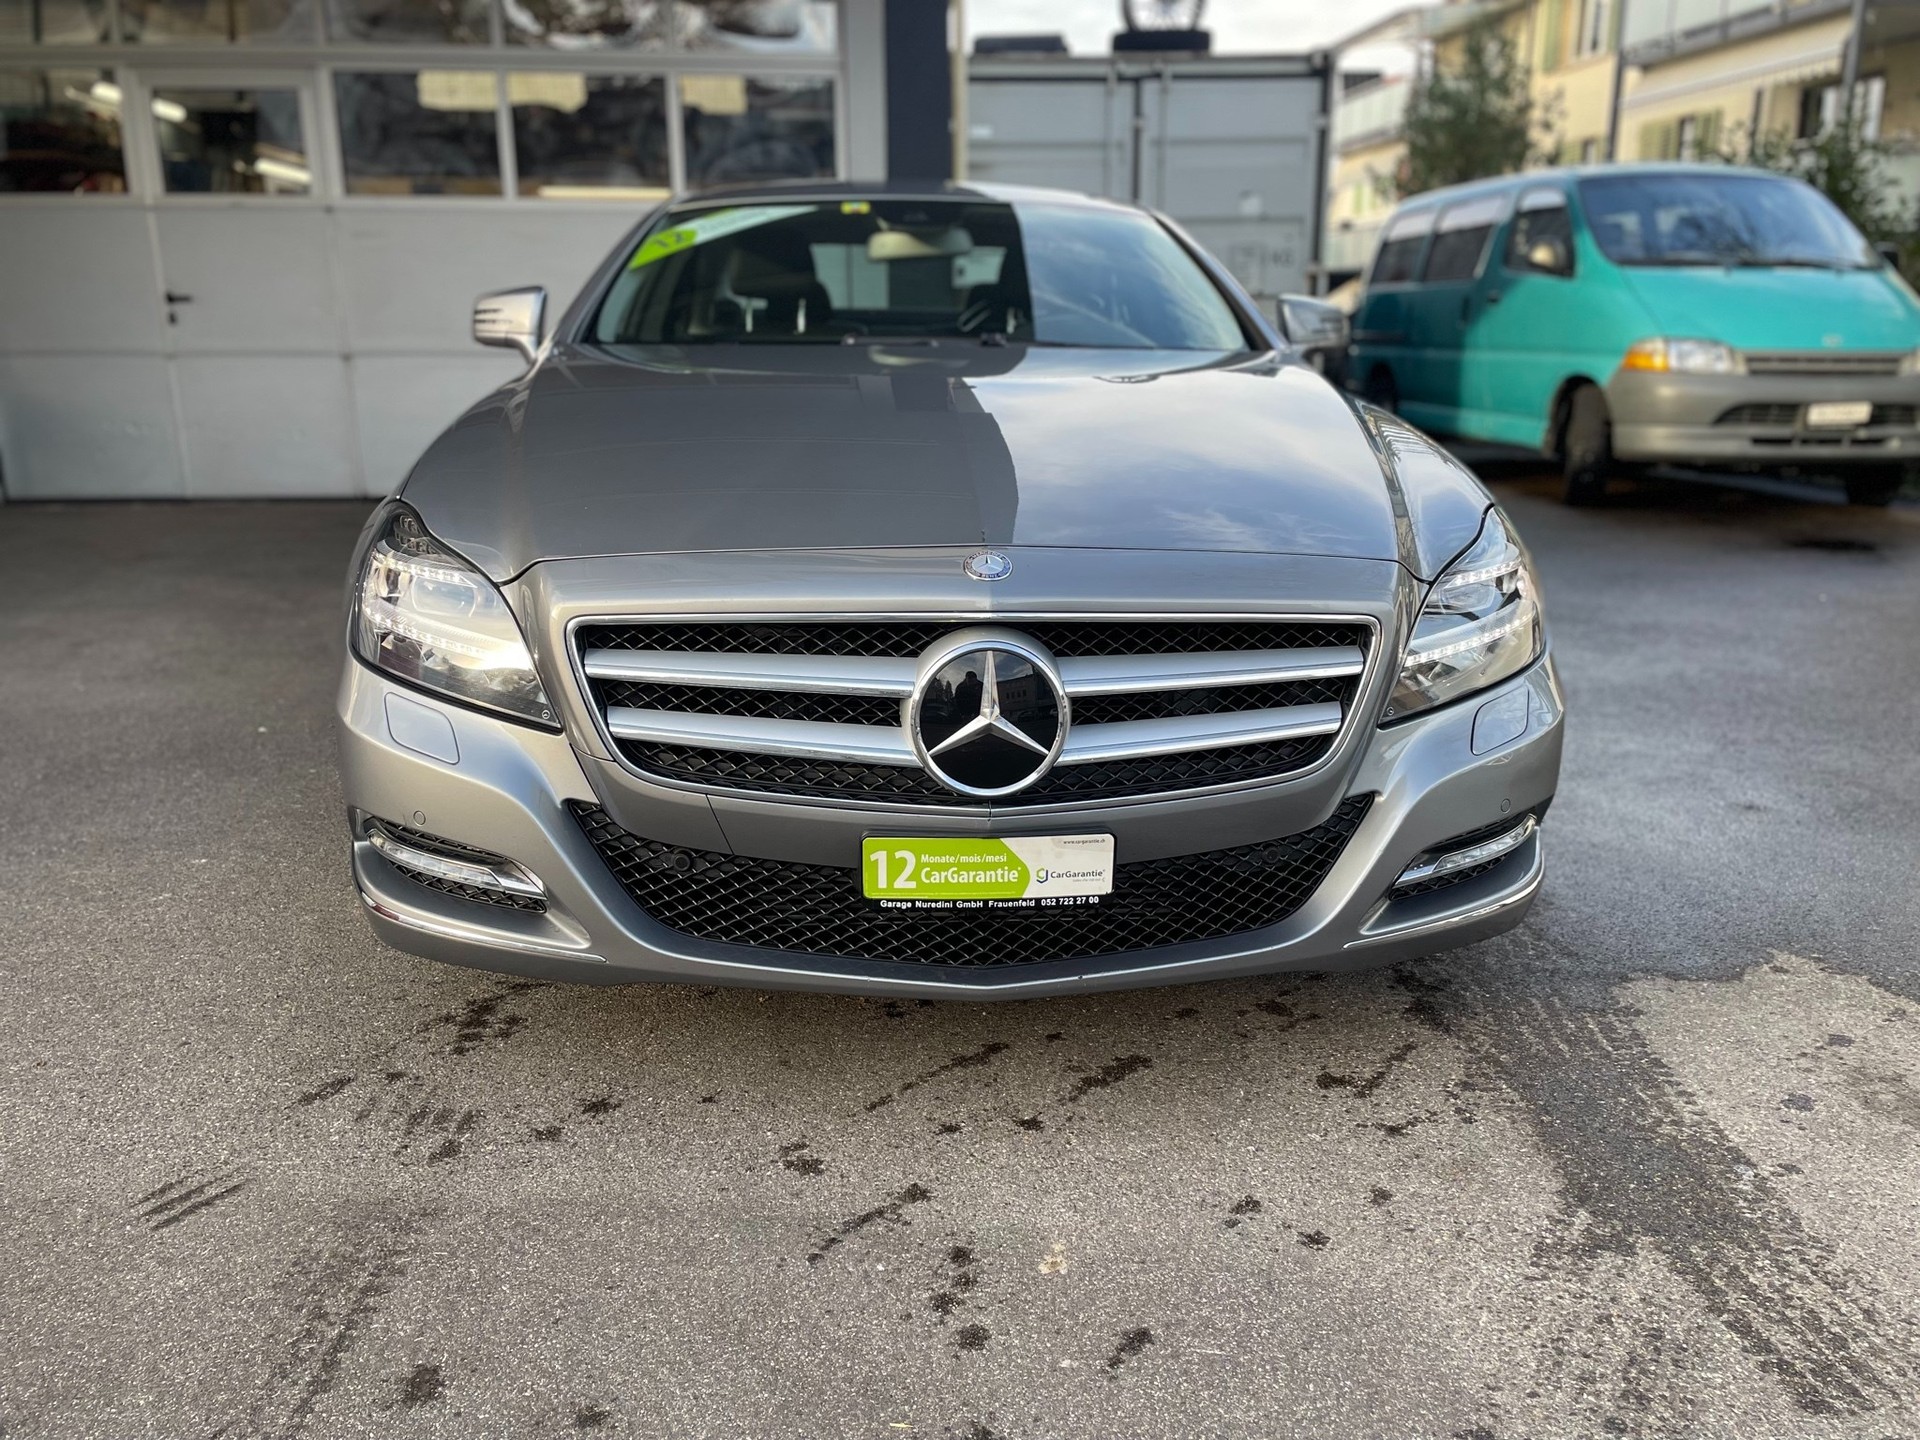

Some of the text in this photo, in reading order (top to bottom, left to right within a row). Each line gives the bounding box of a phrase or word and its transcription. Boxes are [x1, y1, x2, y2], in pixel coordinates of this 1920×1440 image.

[921, 853, 1007, 863] Monate/mois/mesi
[870, 850, 917, 889] 12
[880, 896, 1099, 909] Garage Nuredini GmbH Frauenfeld 052 722 27 00
